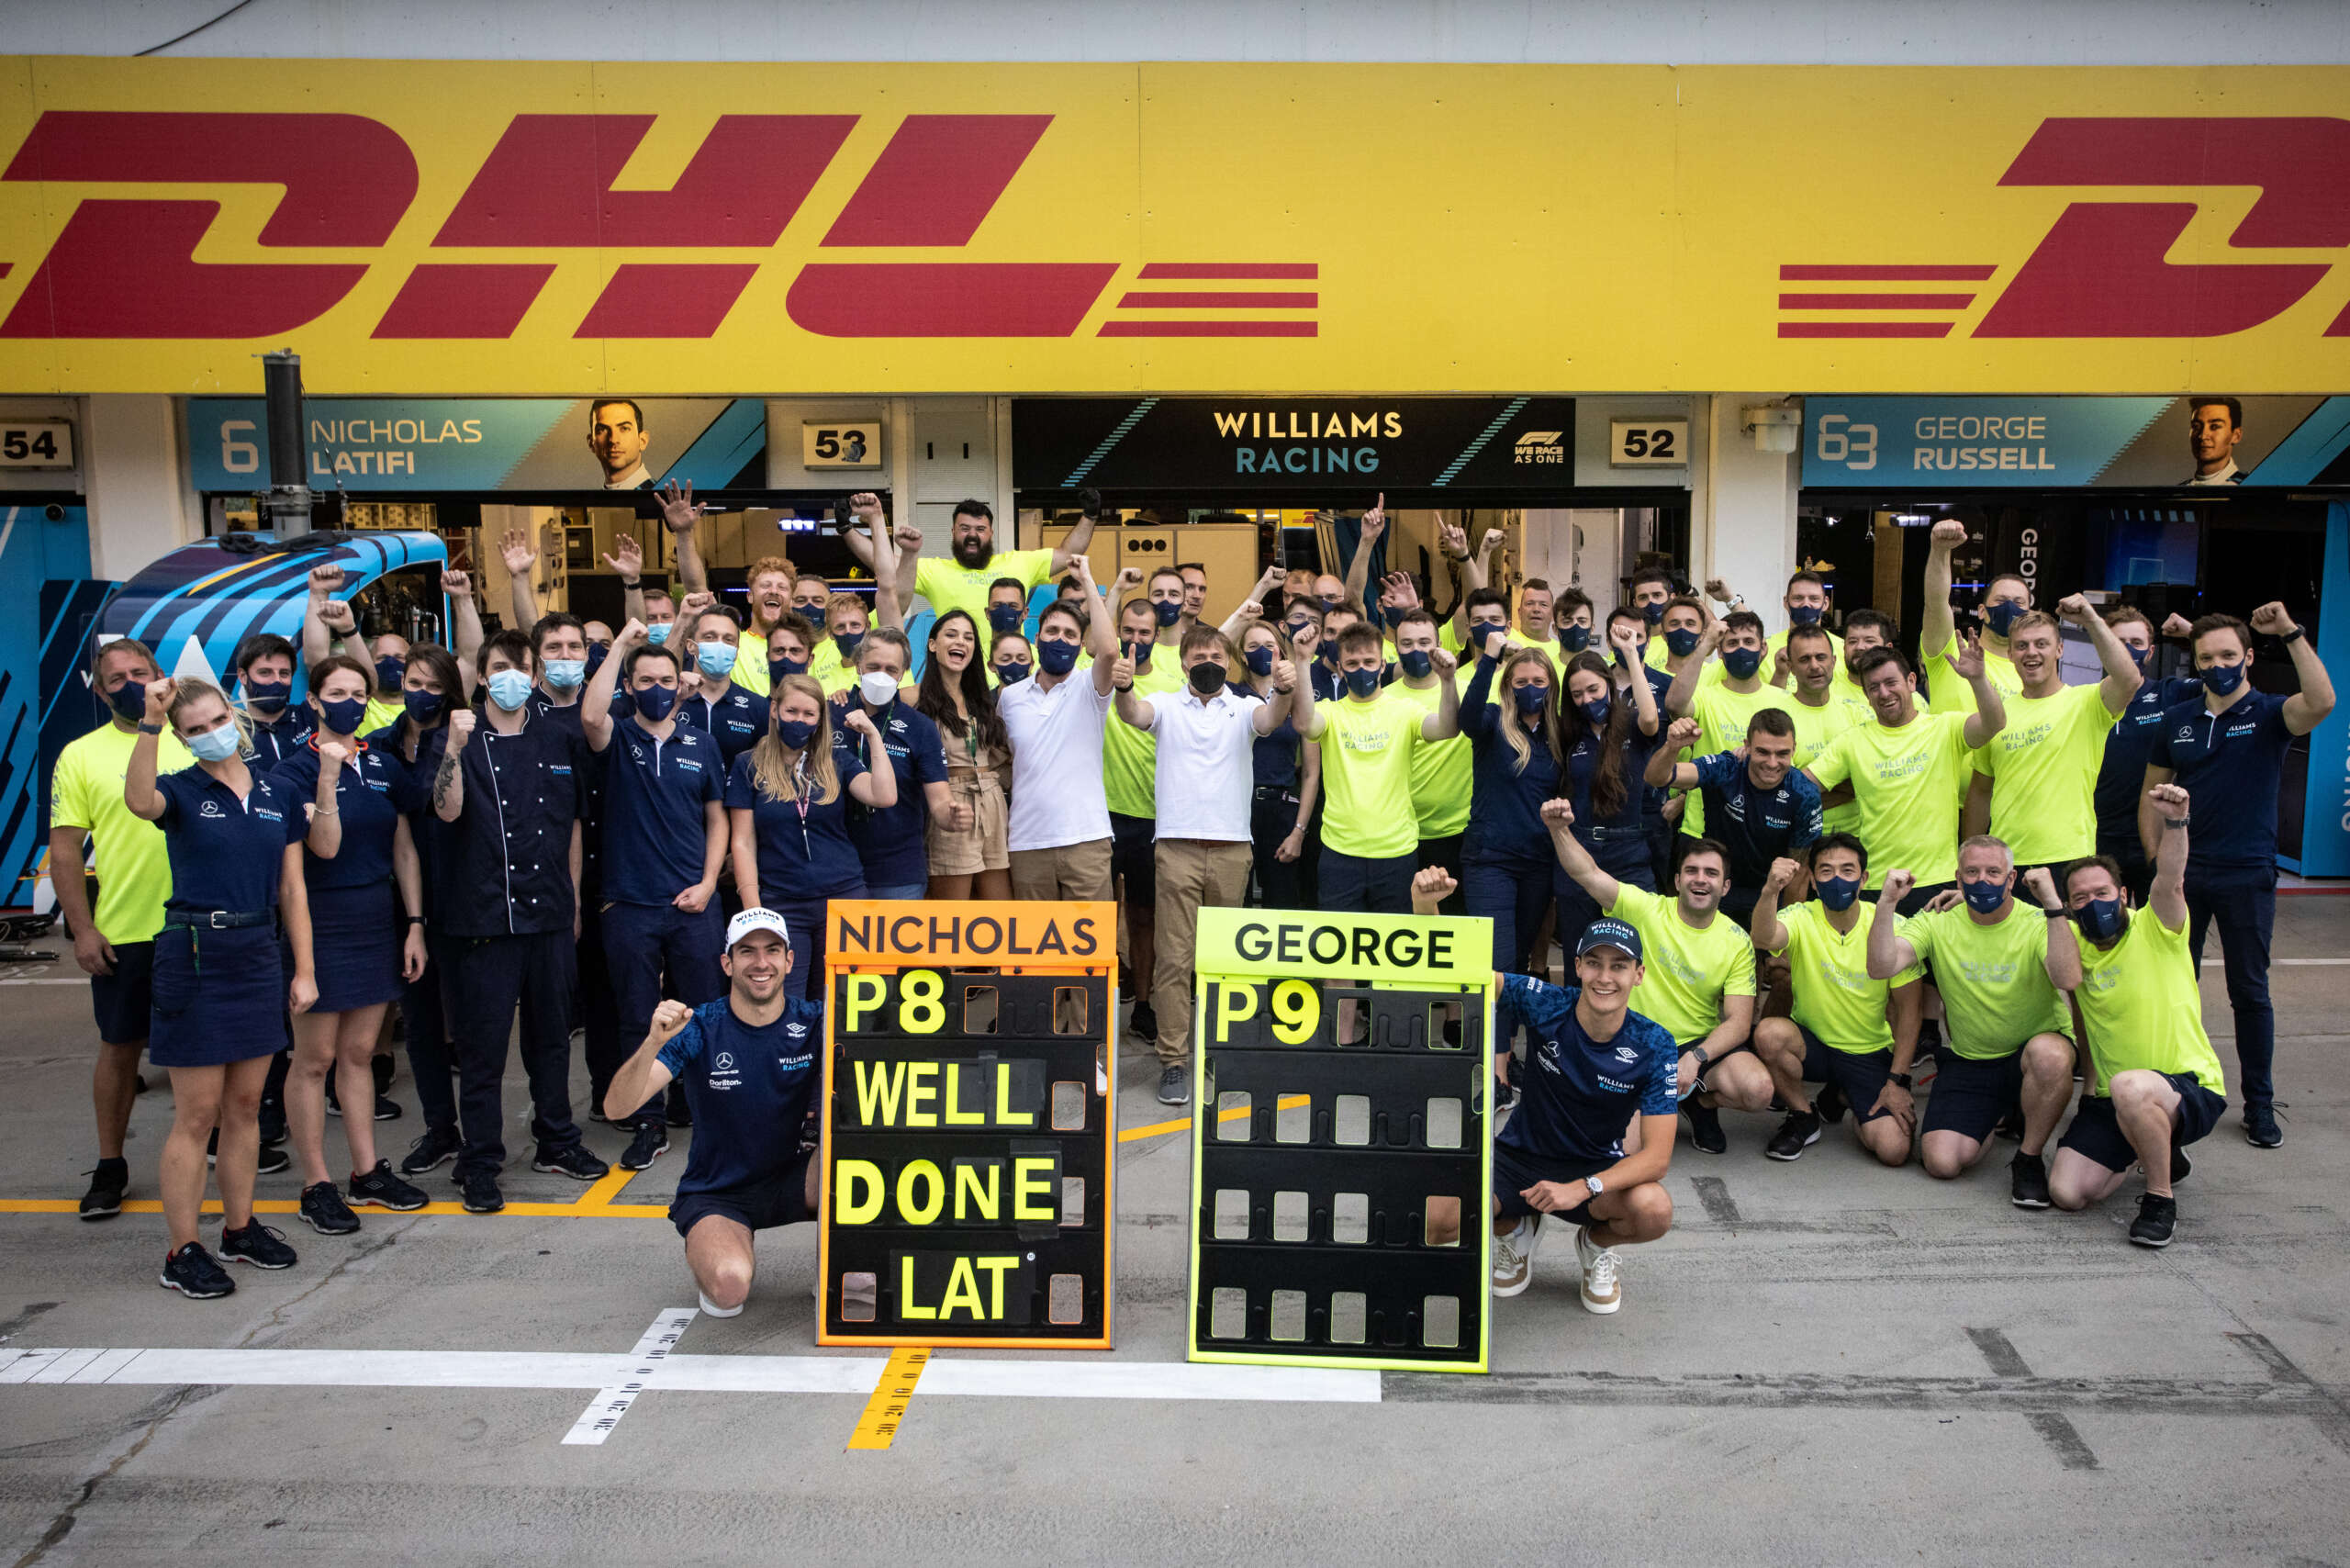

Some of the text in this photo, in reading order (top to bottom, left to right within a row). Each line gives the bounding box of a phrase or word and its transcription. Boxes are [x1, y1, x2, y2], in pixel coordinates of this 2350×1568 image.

[0, 110, 1121, 338] DHL
[310, 420, 483, 443] NICHOLAS
[1214, 411, 1403, 439] WILLIAMS
[1915, 417, 2046, 440] GEORGE
[3, 430, 58, 460] 54
[220, 420, 260, 474] 6
[814, 430, 867, 460] 53
[1515, 446, 1563, 455] WE RACE
[1623, 429, 1675, 458] 52
[1818, 414, 1878, 470] 63
[312, 451, 415, 475] LATIFI
[1236, 447, 1380, 474] RACING
[1515, 454, 1563, 464] AS ONE
[1913, 447, 2056, 471] RUSSELL
[2020, 528, 2038, 609] GEOR
[2229, 722, 2256, 733] ILLIAMS
[885, 749, 907, 758] ACING
[838, 915, 1098, 957] NICHOLAS
[1591, 922, 1635, 937] WILLIAMS
[1593, 928, 1629, 940] RACING
[1235, 922, 1454, 969] GEORGE
[845, 969, 946, 1035] P8
[1215, 979, 1321, 1046] P9
[778, 1053, 813, 1065] WILLIAMS
[782, 1061, 811, 1071] RACING
[854, 1060, 1034, 1127] WELL
[835, 1159, 1055, 1226] DONE
[901, 1256, 1020, 1320] LAT
